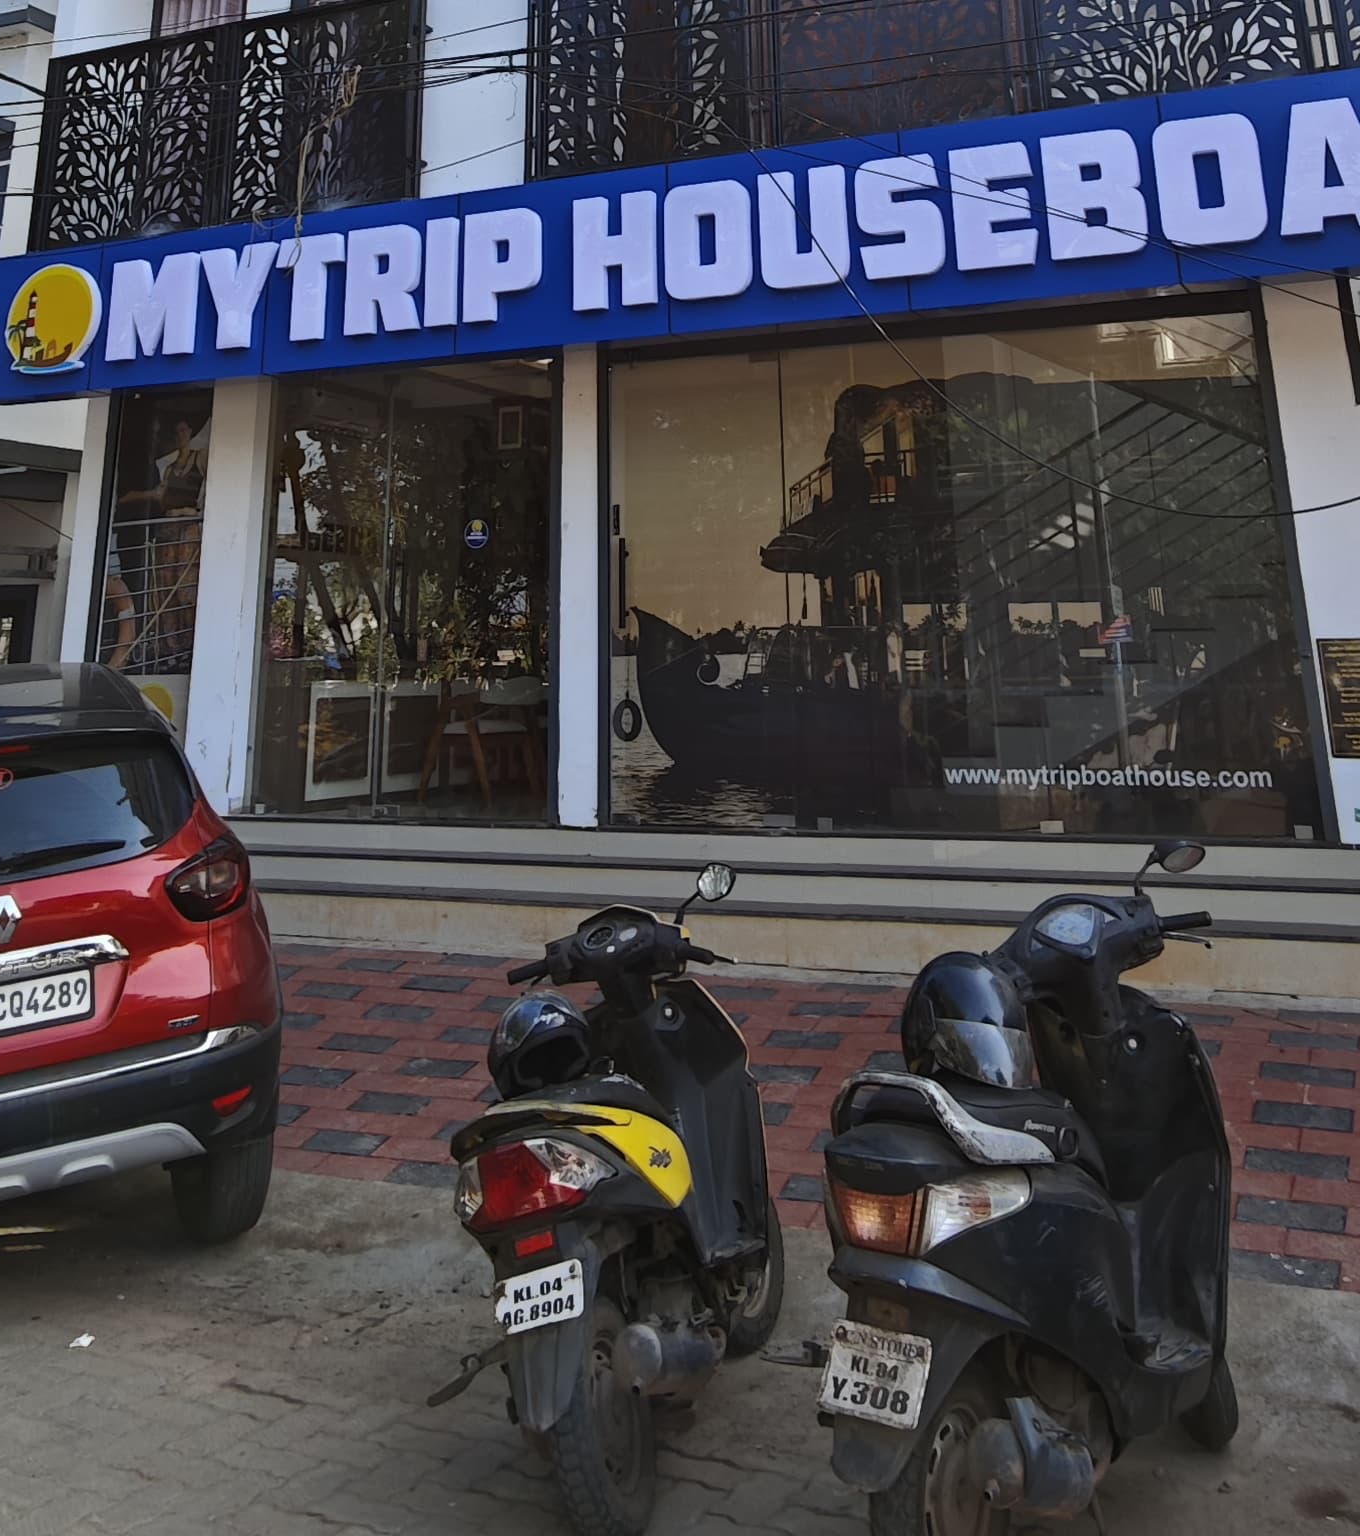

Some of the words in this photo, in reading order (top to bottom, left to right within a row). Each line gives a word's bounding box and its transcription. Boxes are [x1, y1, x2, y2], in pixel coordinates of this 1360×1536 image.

[103, 207, 544, 363] MYTRIP
[944, 763, 1273, 791] www.mytripboathouse.com
[832, 1375, 910, 1415] Y.308
